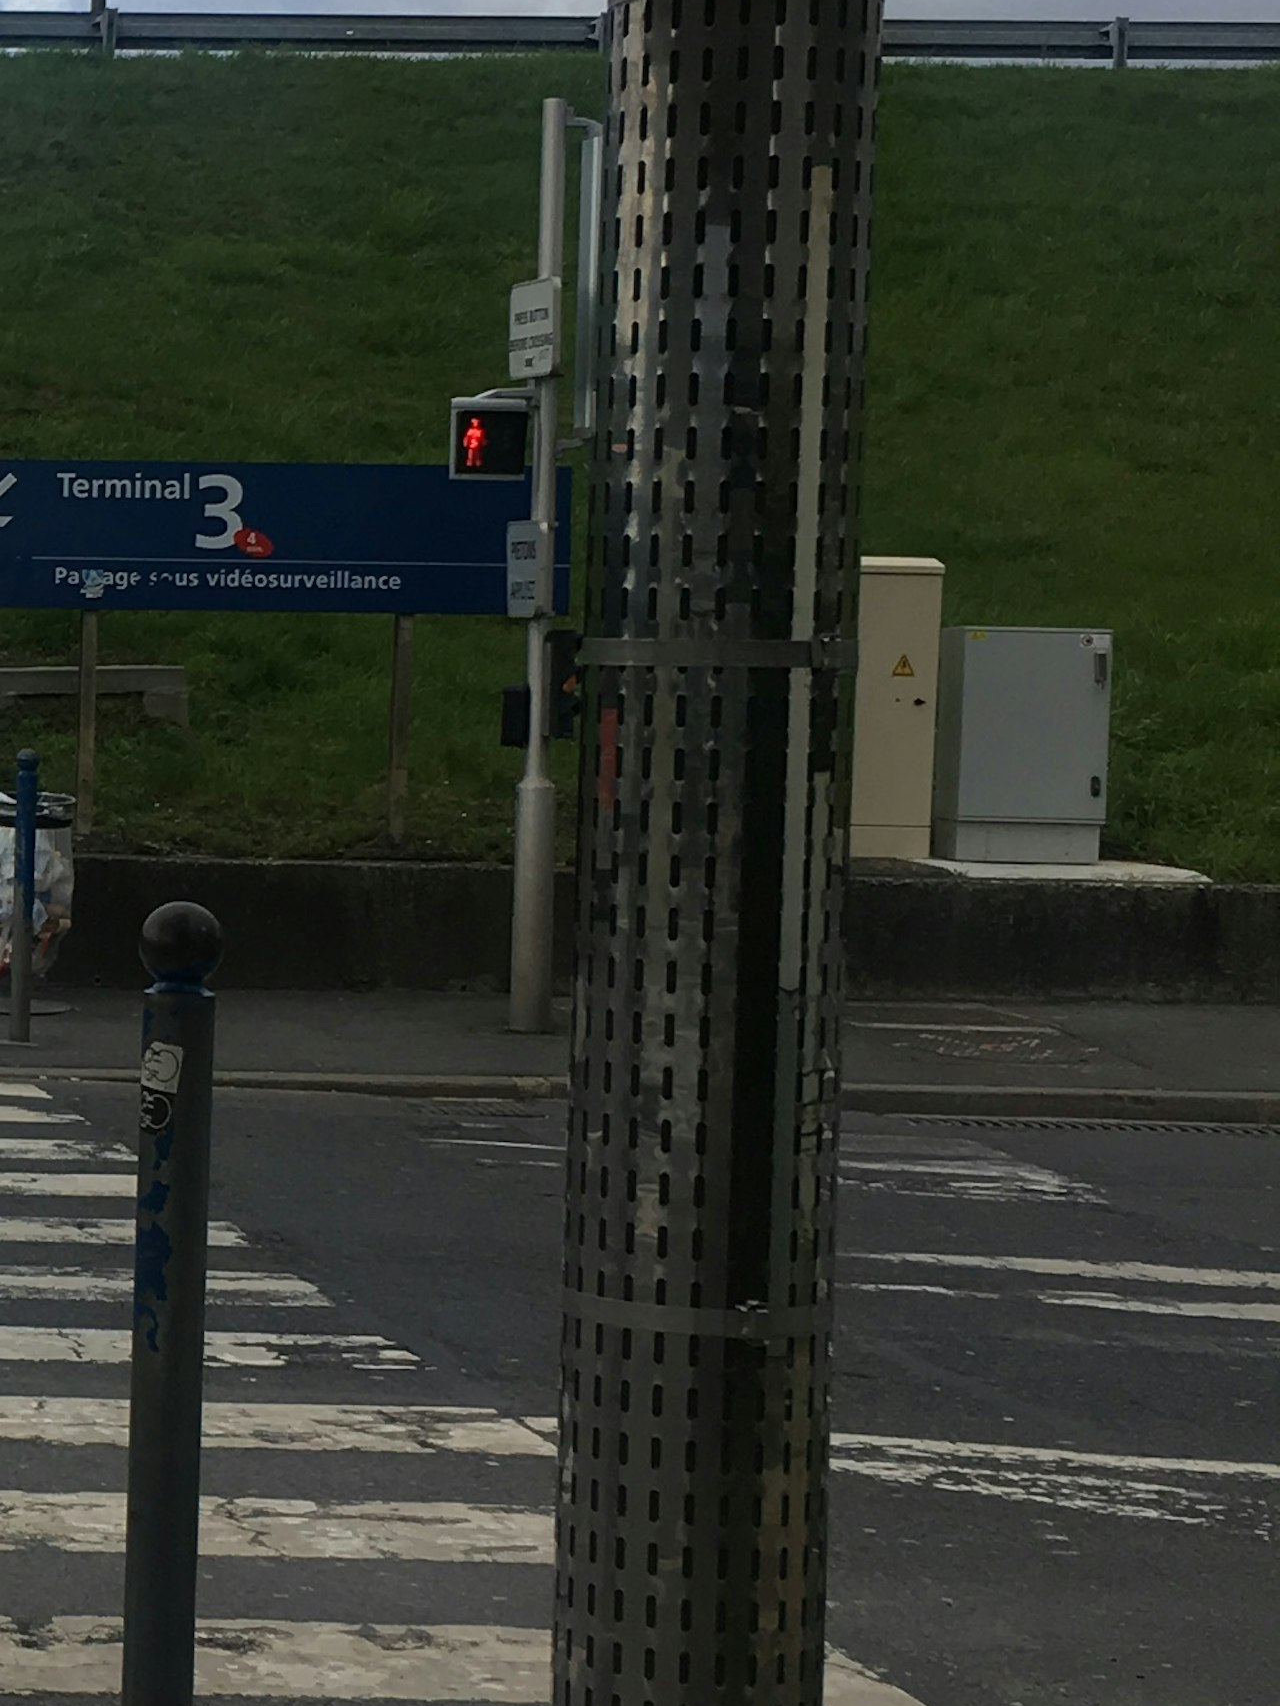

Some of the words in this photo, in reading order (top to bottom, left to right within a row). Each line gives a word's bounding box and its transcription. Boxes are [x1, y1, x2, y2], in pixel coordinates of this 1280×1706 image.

[56, 472, 191, 501] Terminal
[194, 473, 244, 550] 3
[54, 566, 143, 590] Paage
[206, 568, 402, 590] vidéosurveillance
